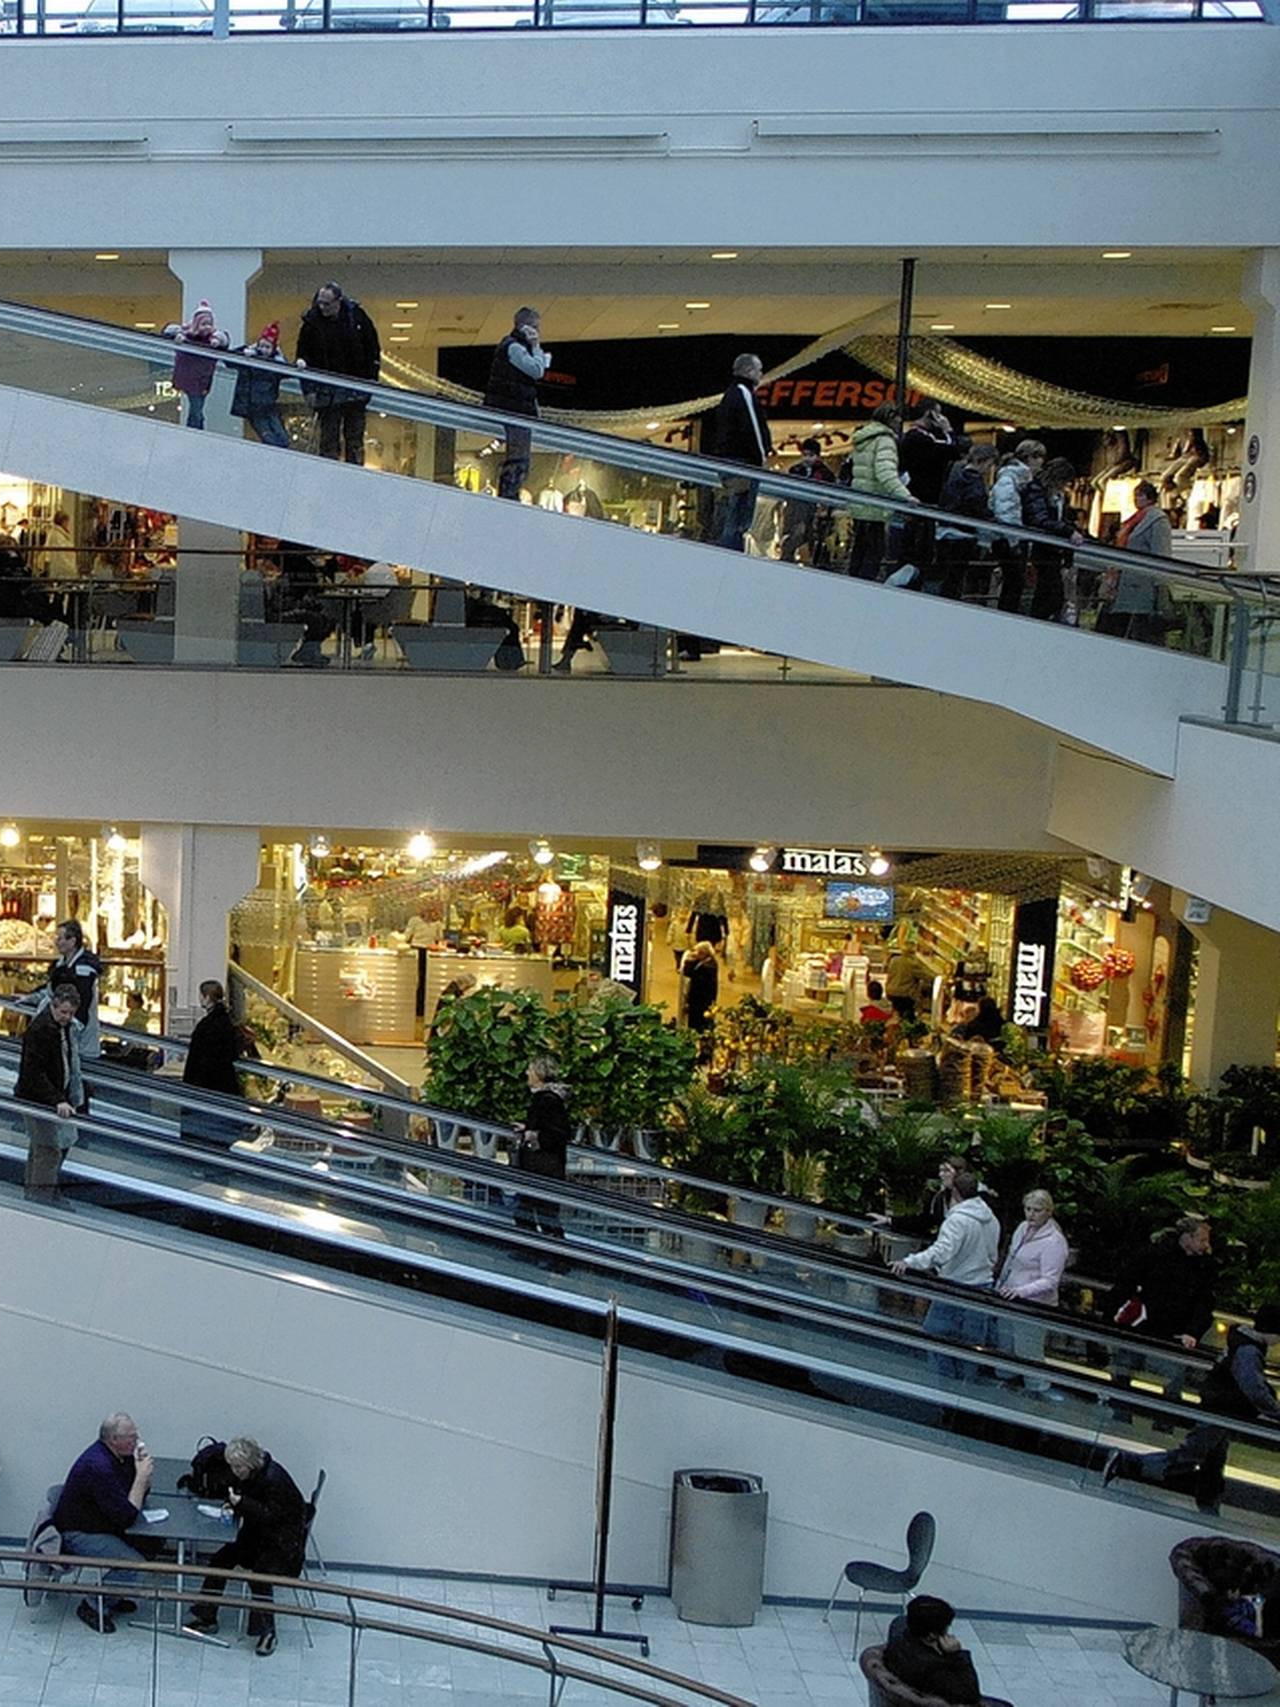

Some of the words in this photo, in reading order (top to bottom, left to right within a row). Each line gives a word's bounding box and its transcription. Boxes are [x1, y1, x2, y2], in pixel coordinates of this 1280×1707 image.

[782, 848, 868, 876] matas
[608, 904, 638, 982] matas
[1013, 941, 1047, 1027] matas
